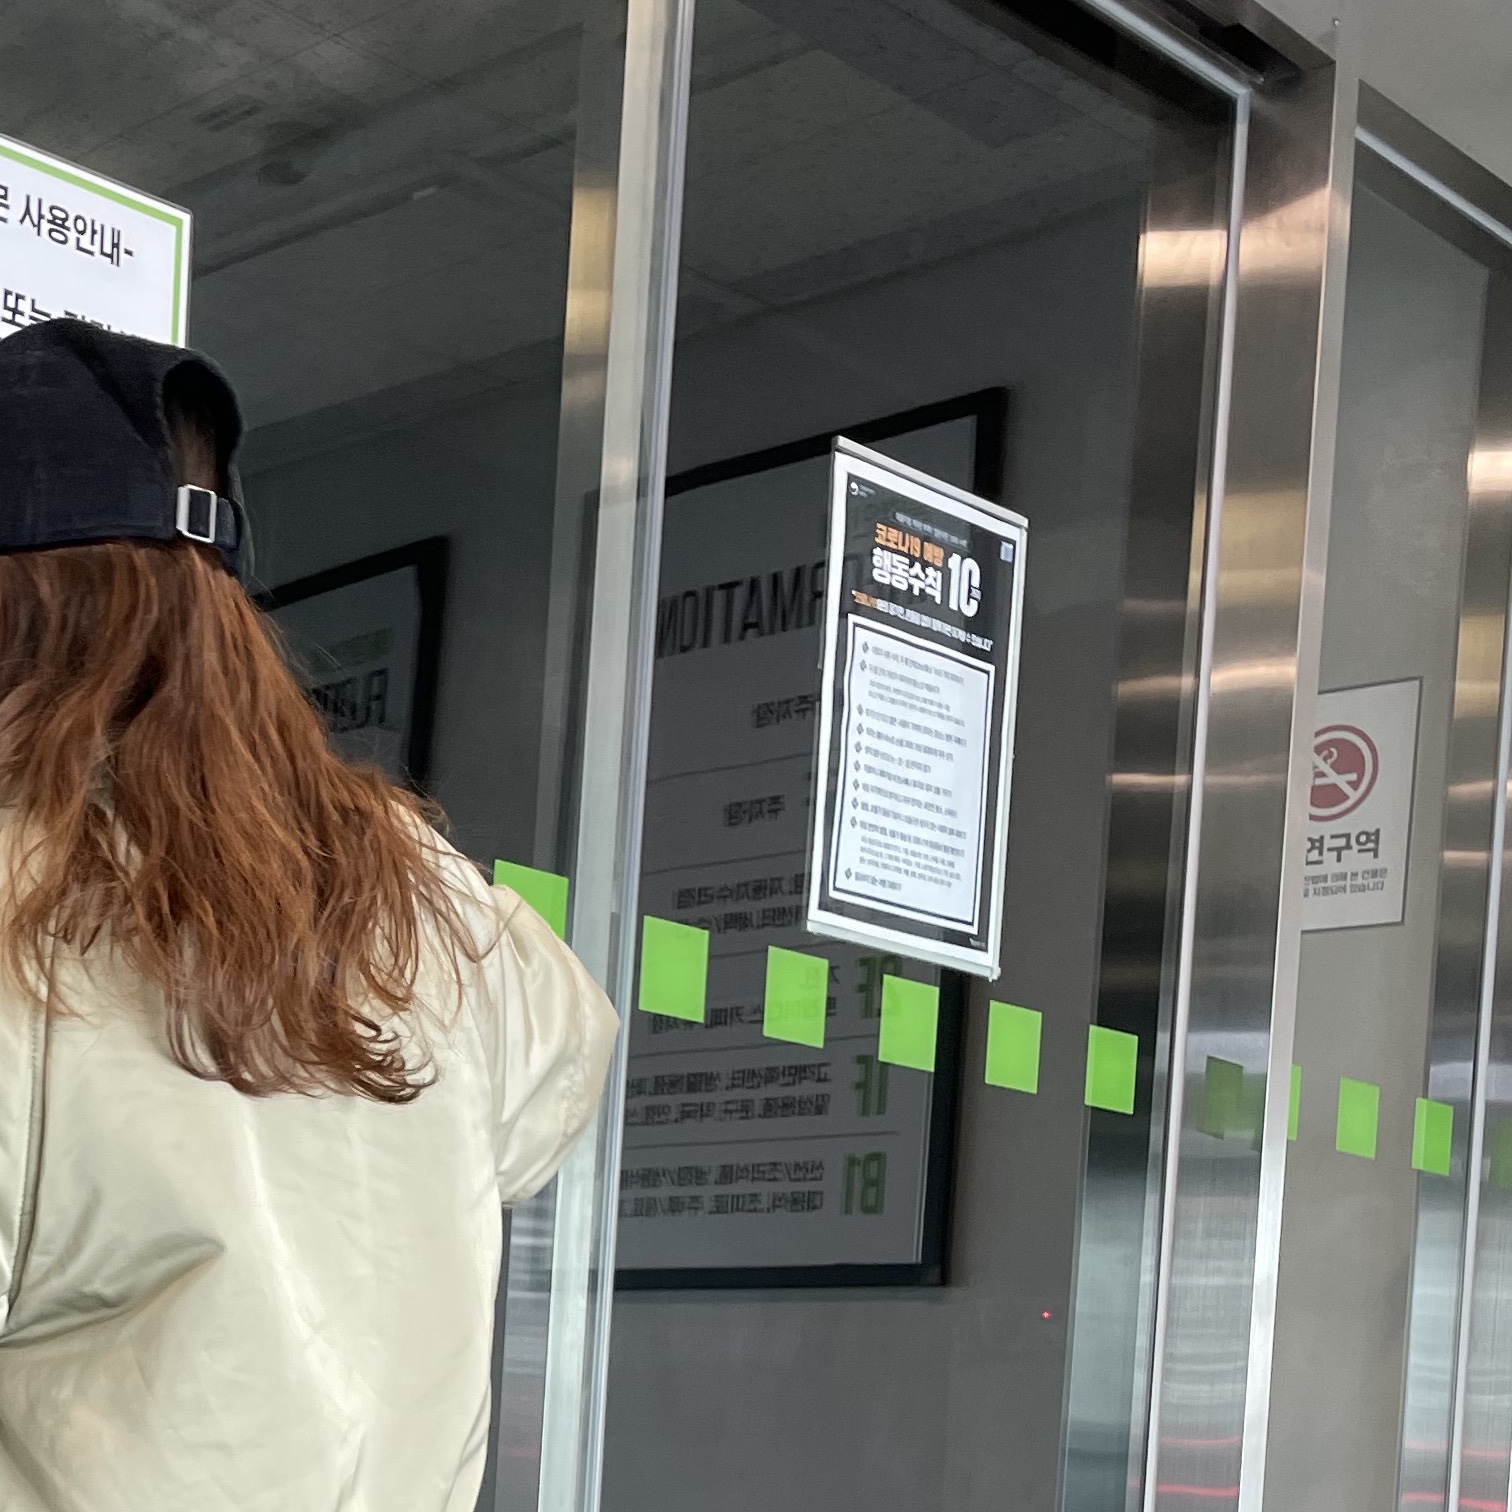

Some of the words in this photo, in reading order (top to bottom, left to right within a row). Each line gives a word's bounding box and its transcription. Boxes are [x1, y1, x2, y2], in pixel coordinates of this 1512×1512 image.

[874, 522, 921, 558] 코로나19
[871, 547, 943, 605] 행동수칙
[947, 551, 983, 618] 10
[1305, 828, 1381, 866] 연구역
